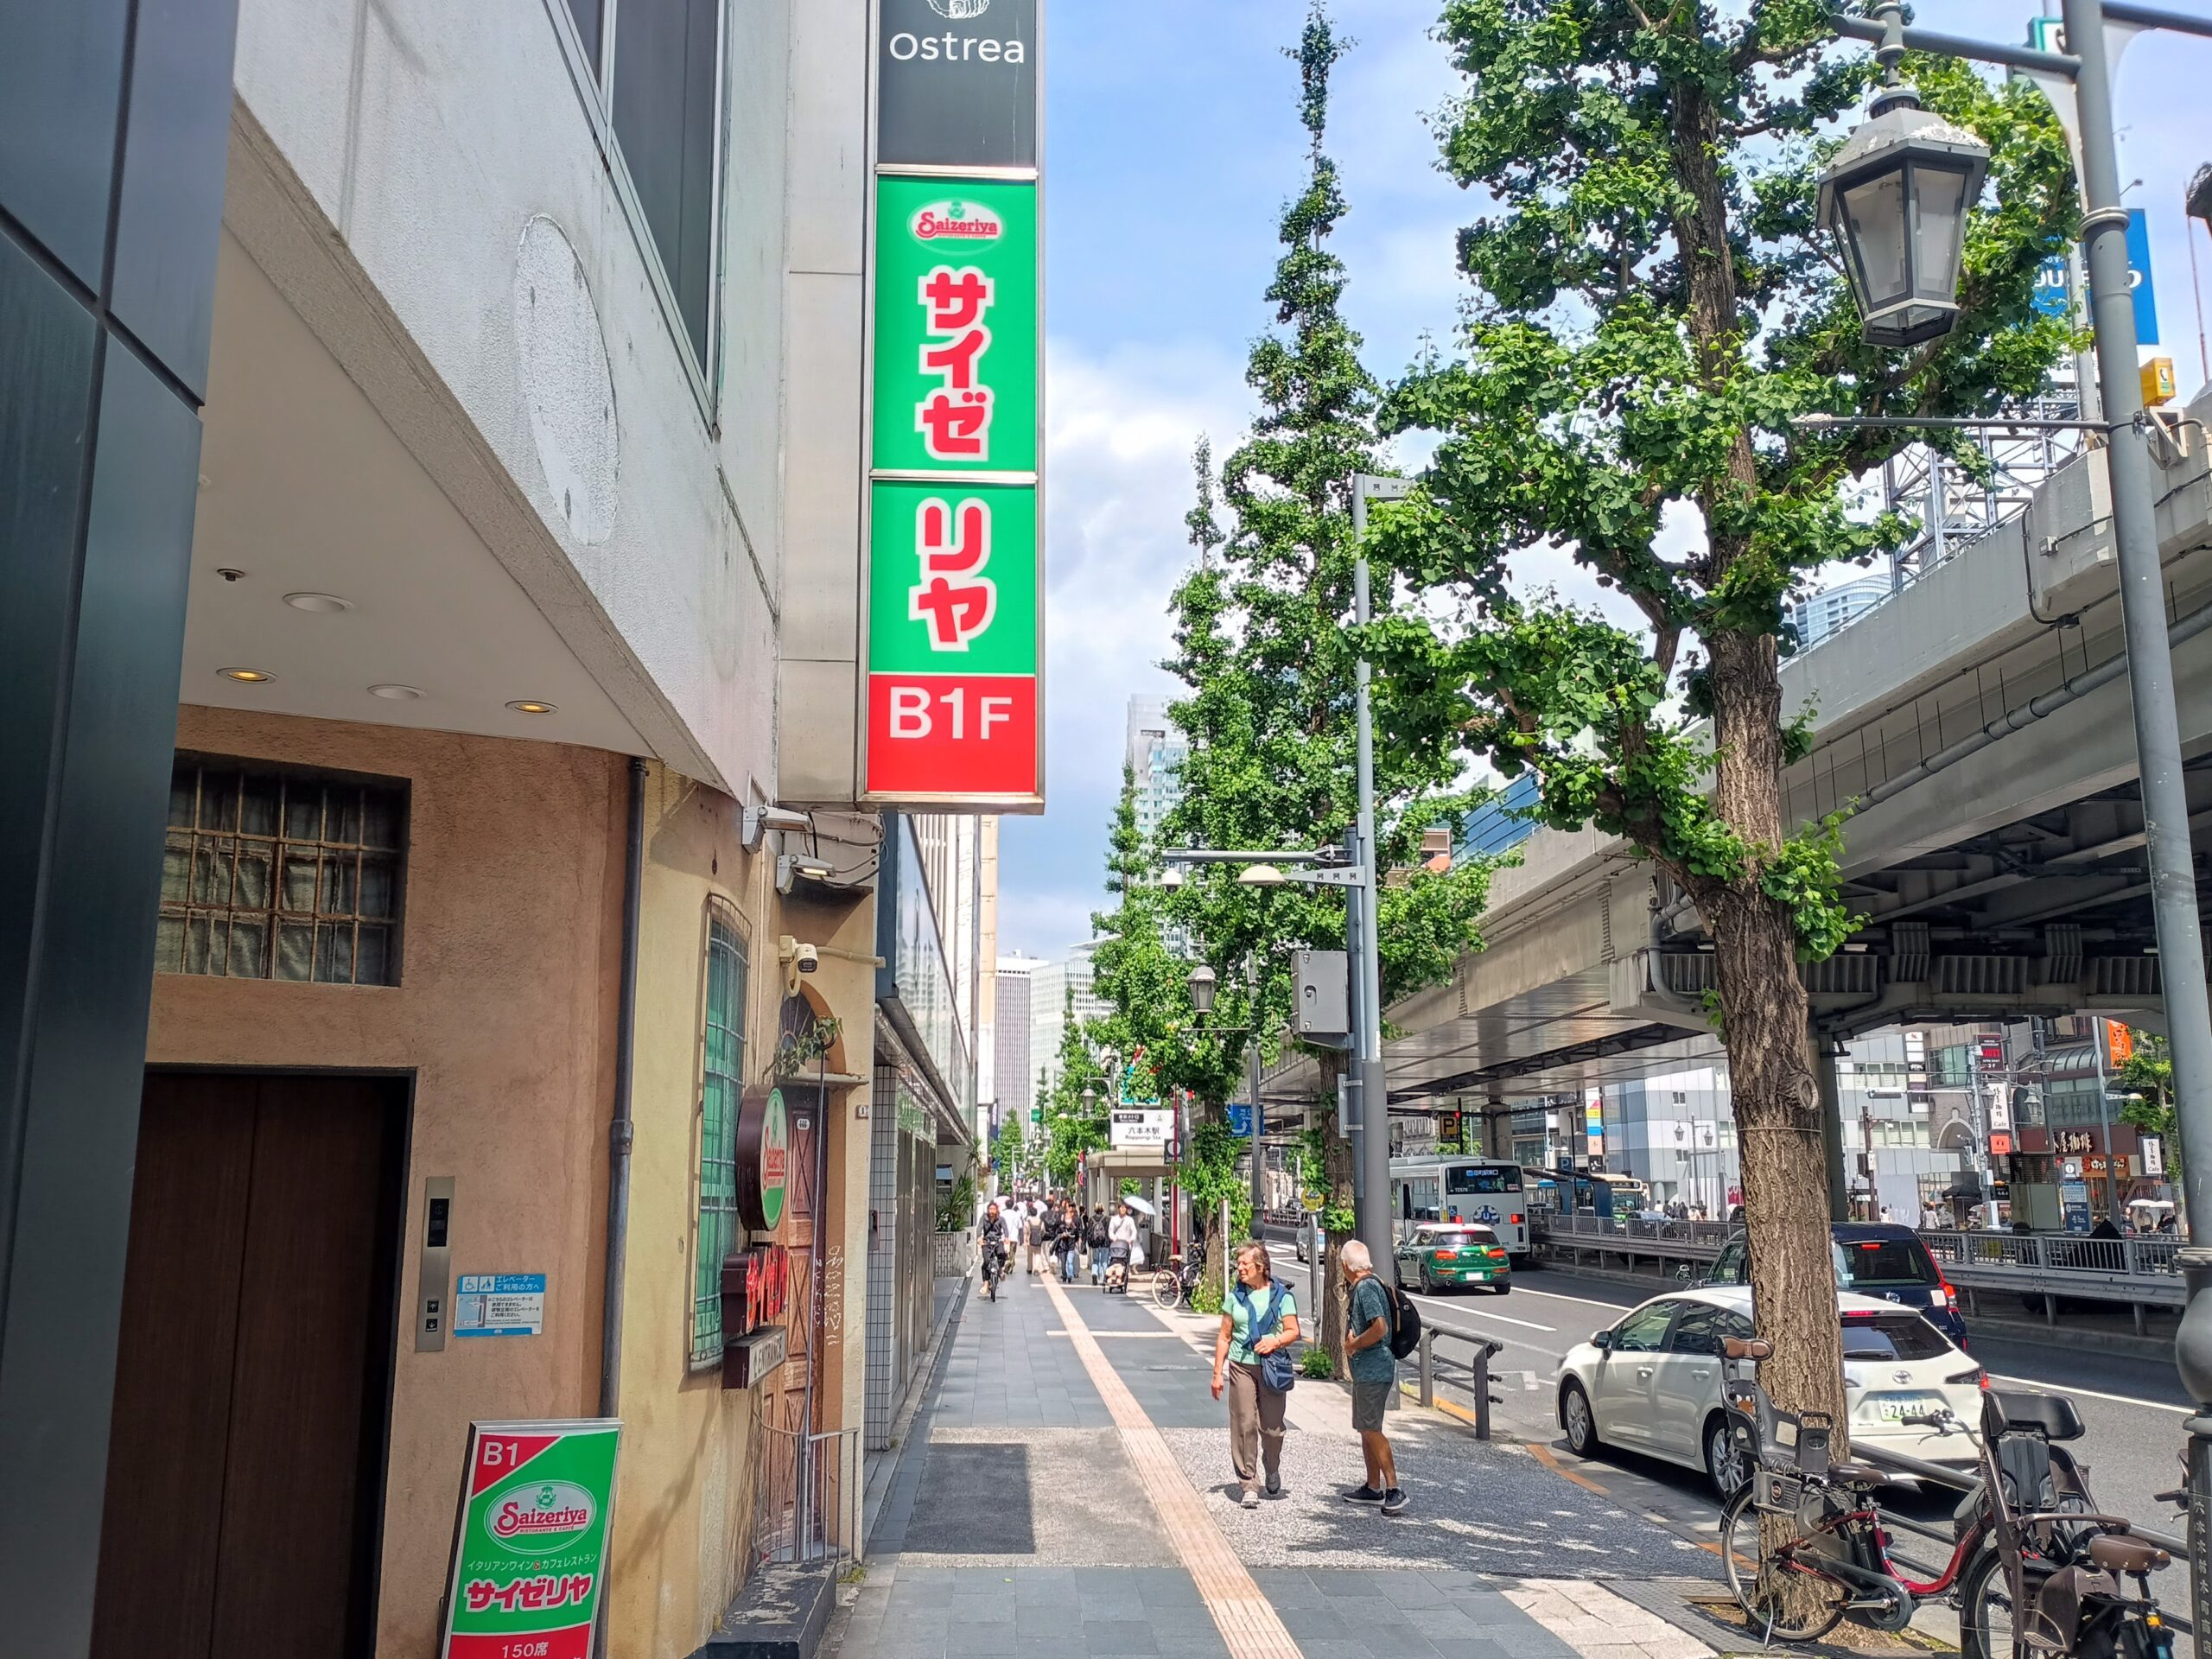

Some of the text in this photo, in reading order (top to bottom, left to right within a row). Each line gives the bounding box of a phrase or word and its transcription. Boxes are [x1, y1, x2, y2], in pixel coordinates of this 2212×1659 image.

[889, 31, 1024, 63] Ostrea
[916, 211, 997, 237] Saizeriya
[915, 268, 993, 647] サイゼリヤ
[889, 685, 1012, 741] B1F
[1128, 1126, 1160, 1135] 六本木駅
[1444, 1118, 1454, 1133] P
[1560, 1159, 1569, 1169] P
[482, 1441, 518, 1466] B1
[496, 1502, 587, 1534] Saizeriya
[466, 1574, 593, 1611] サイゼリヤ
[502, 1641, 549, 1659] 150席
